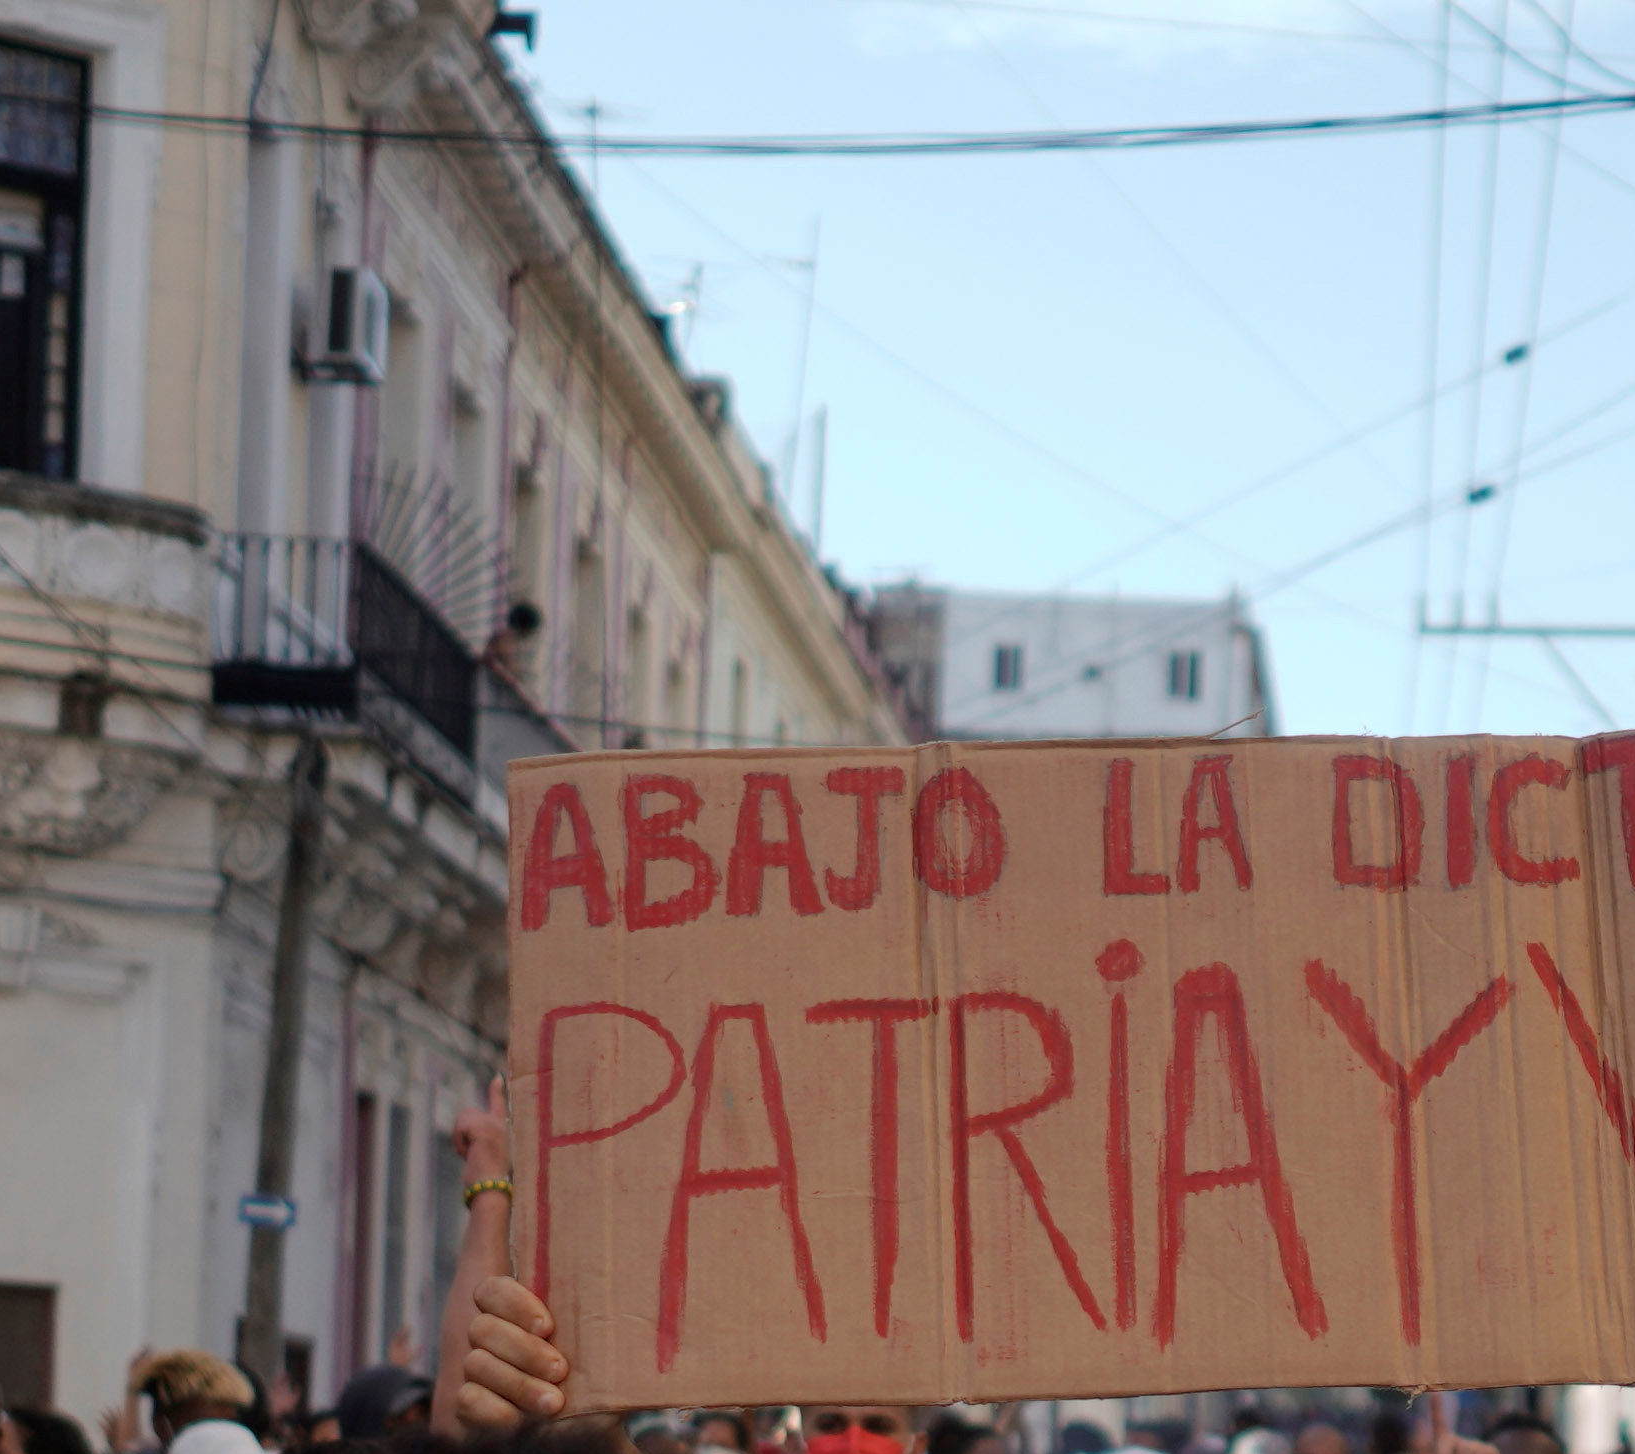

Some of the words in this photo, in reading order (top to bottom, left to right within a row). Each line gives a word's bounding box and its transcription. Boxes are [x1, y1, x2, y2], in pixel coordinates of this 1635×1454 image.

[521, 766, 1008, 933] ABAJO
[1103, 756, 1254, 896] LA
[1303, 957, 1516, 1346] Y
